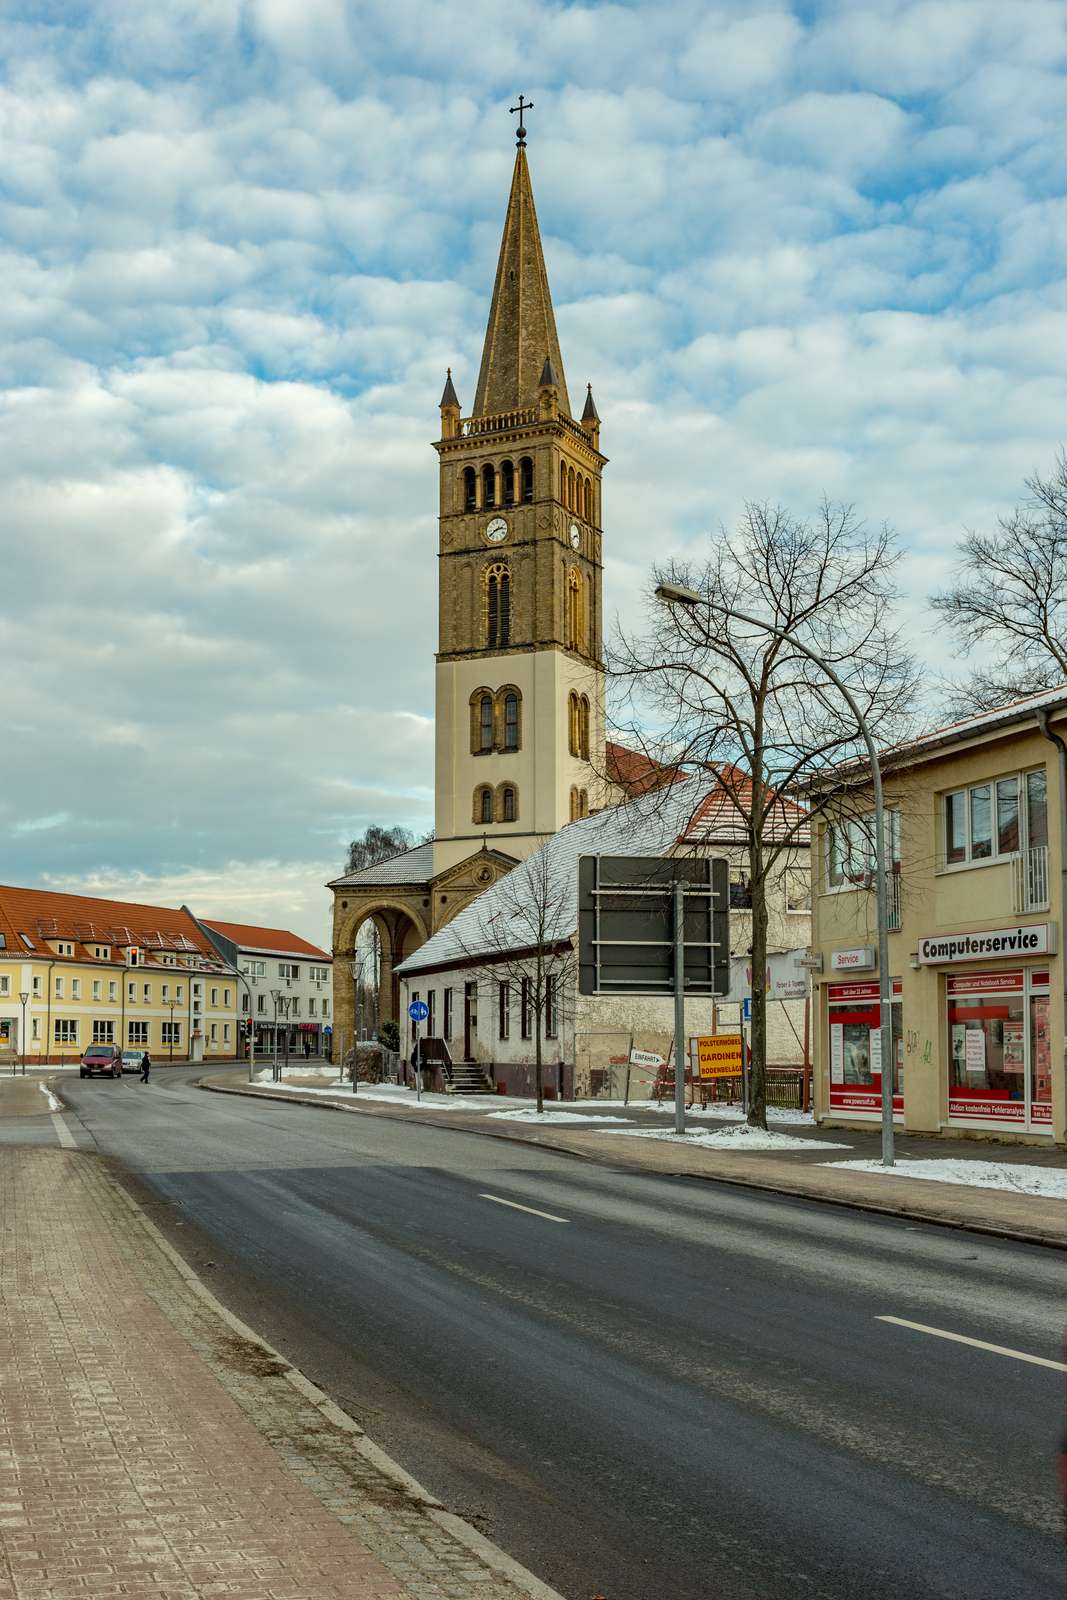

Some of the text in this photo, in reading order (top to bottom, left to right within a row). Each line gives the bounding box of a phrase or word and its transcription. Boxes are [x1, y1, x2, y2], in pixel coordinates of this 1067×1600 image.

[923, 929, 1038, 959] Computerservice
[837, 954, 859, 965] Service
[981, 979, 999, 987] Notebook
[699, 1038, 742, 1047] POLSTERMÖBEL
[634, 1053, 656, 1062] EINFAHRT
[701, 1052, 742, 1062] GARDINEN
[950, 1103, 965, 1112] Aktion
